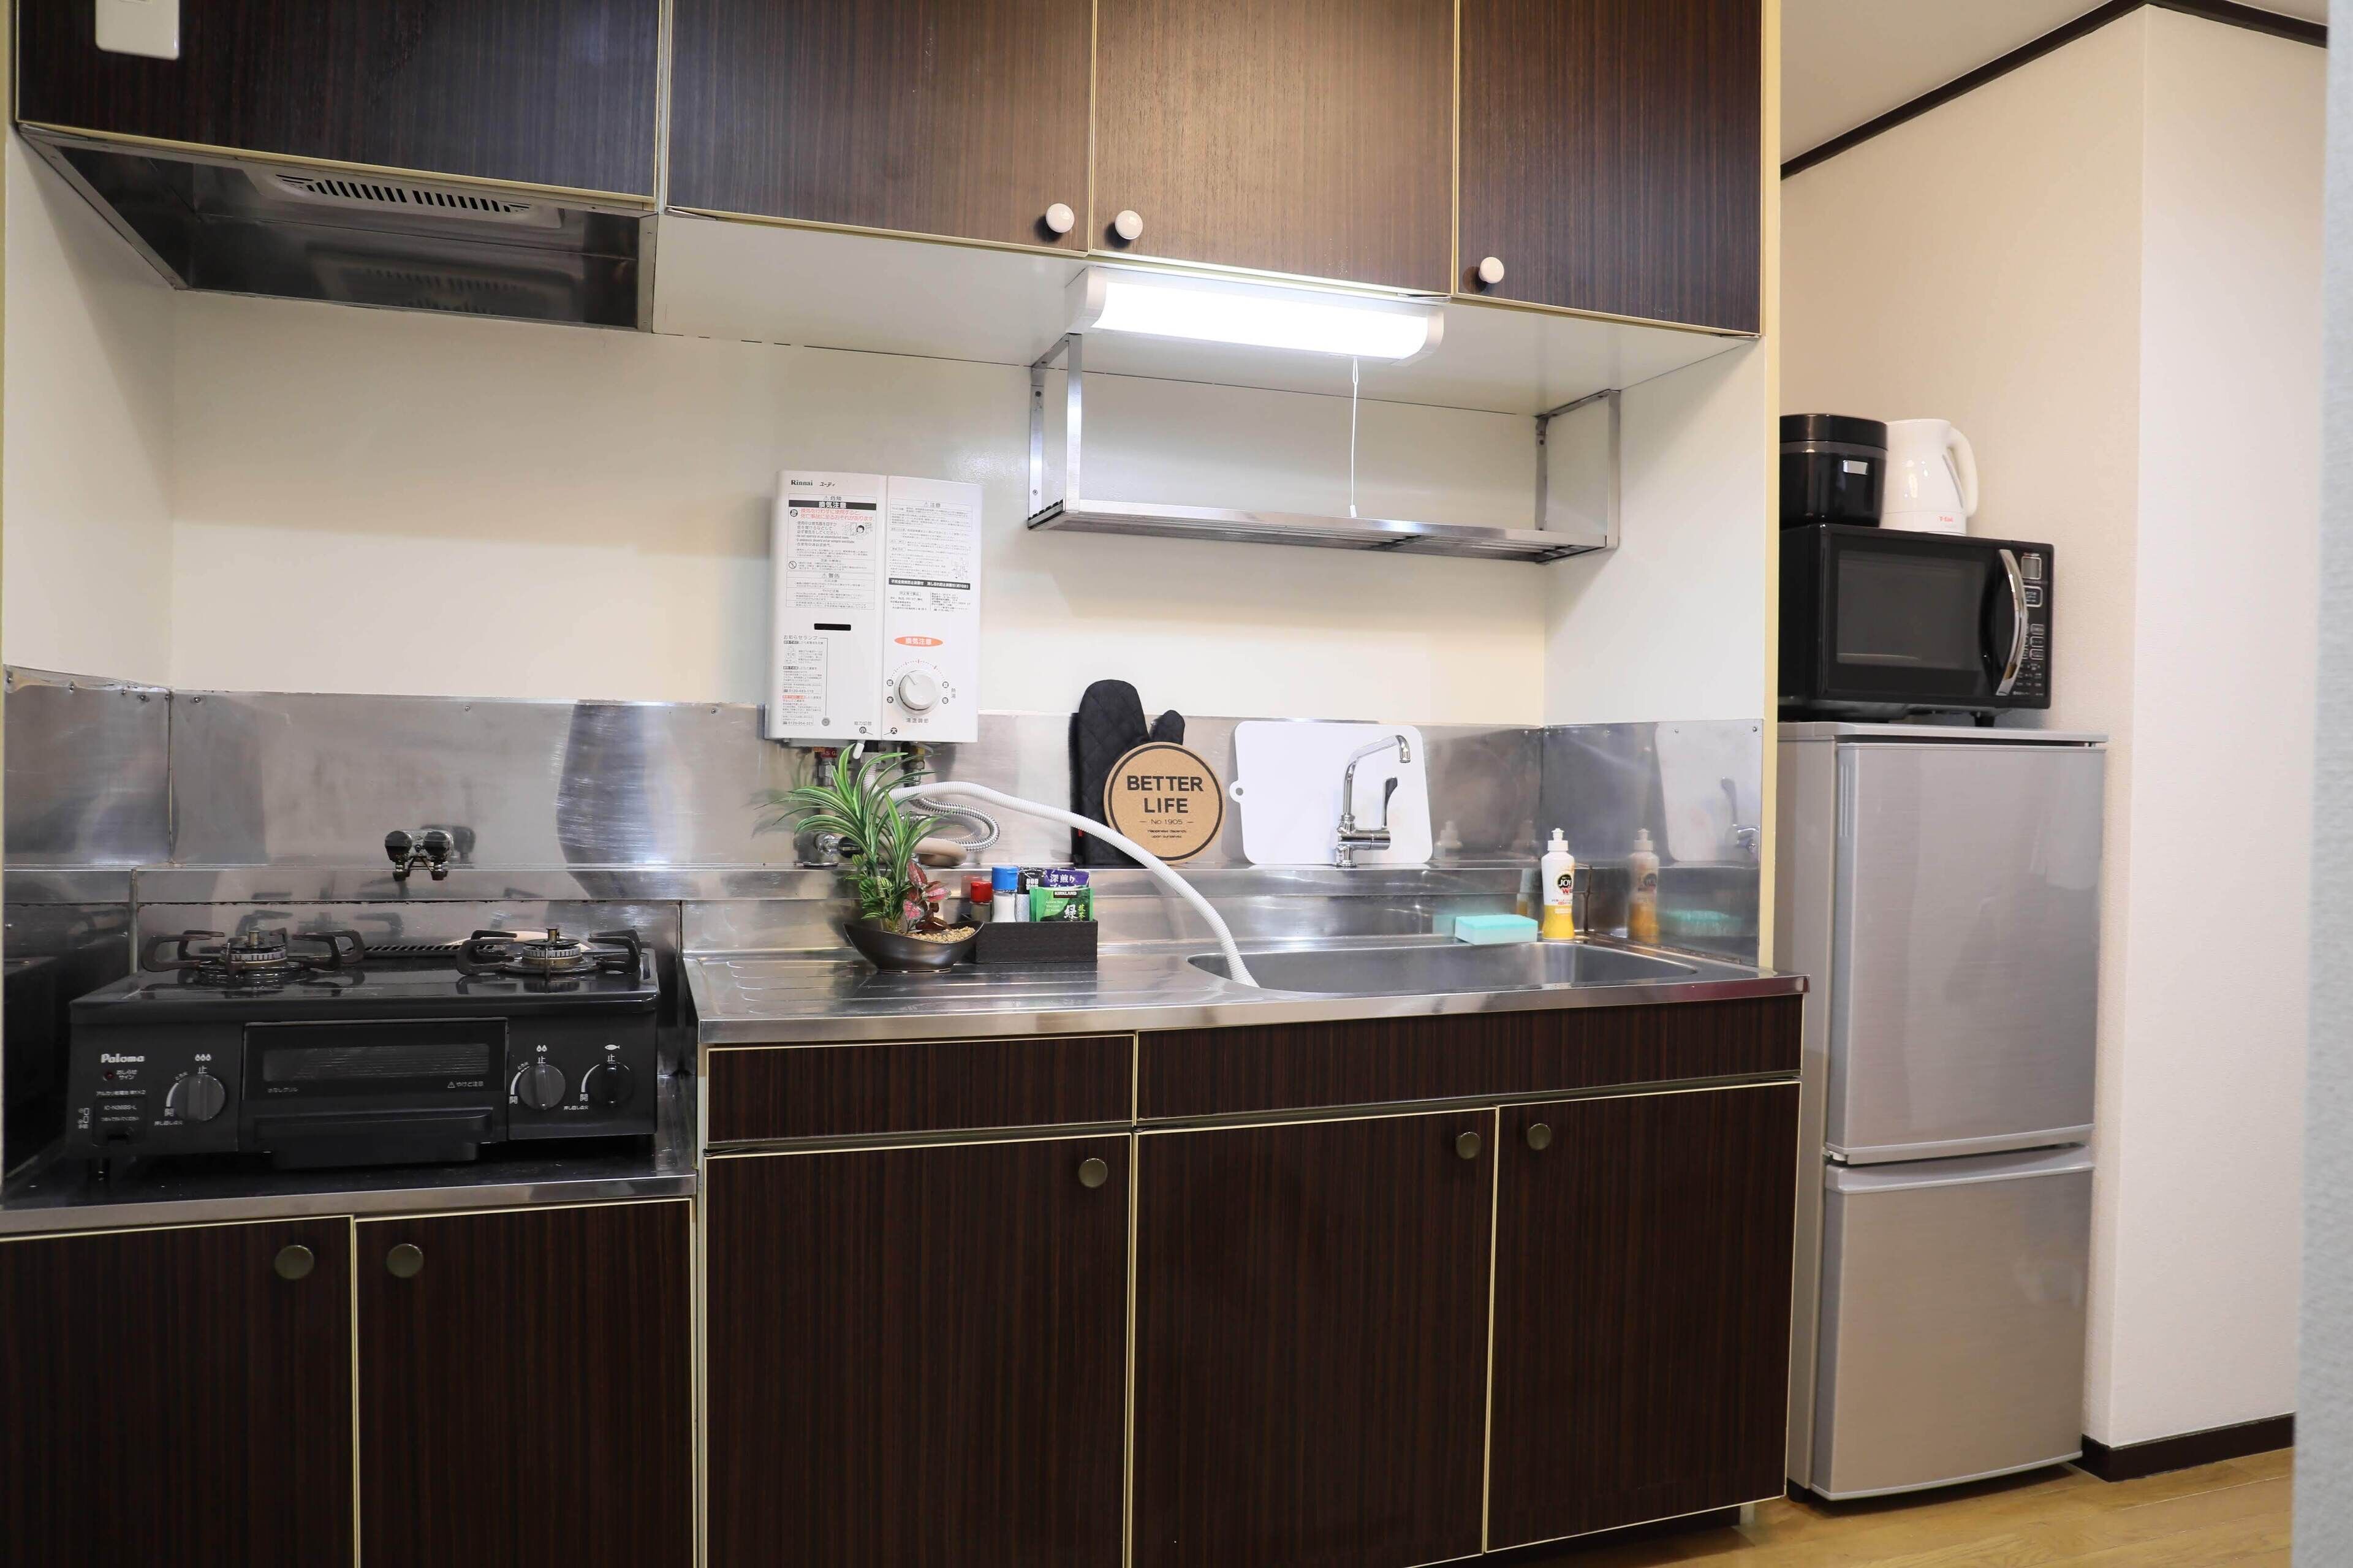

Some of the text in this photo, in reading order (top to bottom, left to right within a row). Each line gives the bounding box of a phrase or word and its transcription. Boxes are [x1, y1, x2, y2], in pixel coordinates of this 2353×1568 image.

[1127, 775, 1203, 792] BETTER
[1144, 798, 1188, 814] LIFE
[1050, 874, 1076, 883] 深煎り
[1064, 904, 1078, 922] 緑
[100, 1053, 145, 1063] Paloma
[197, 1066, 207, 1074] 止
